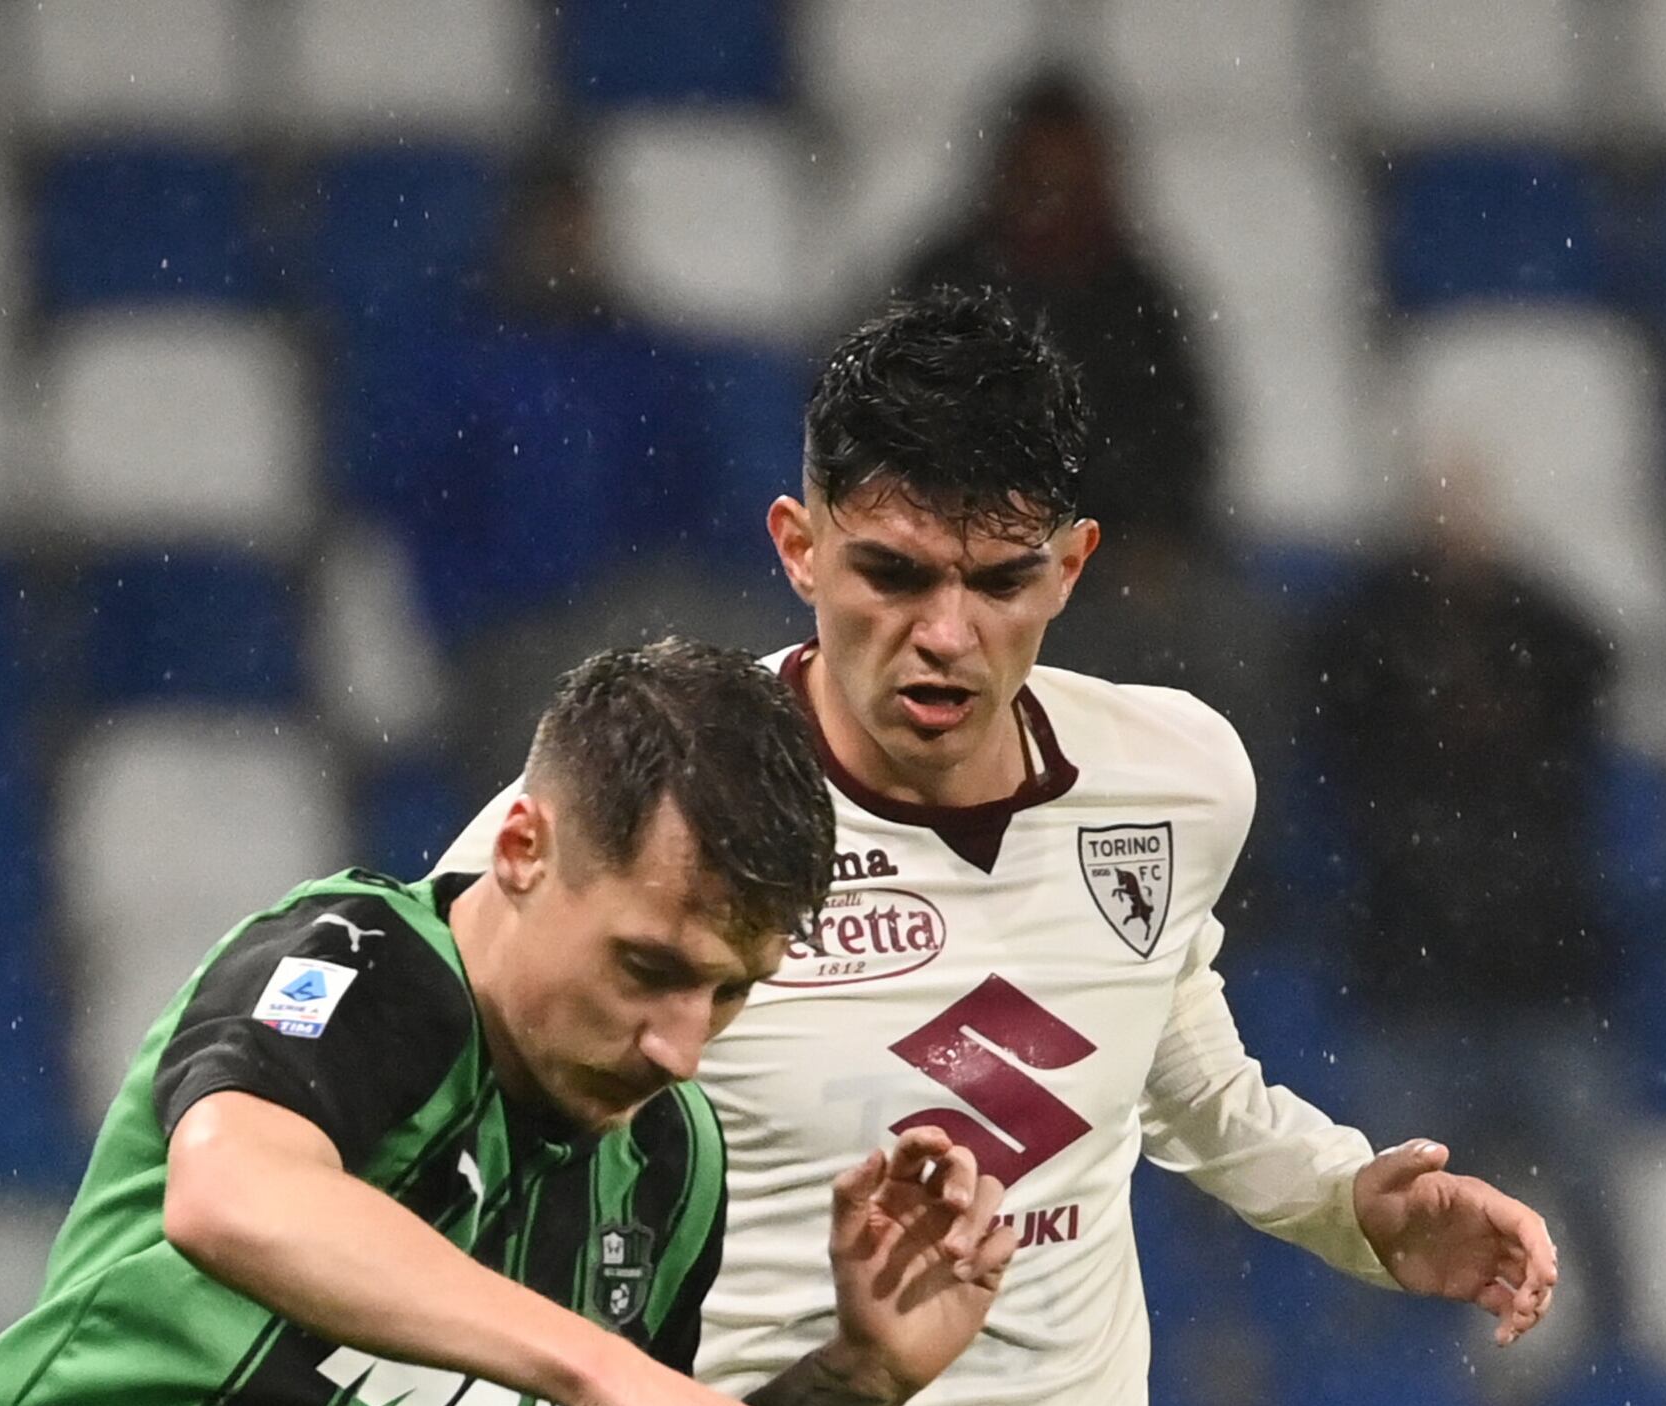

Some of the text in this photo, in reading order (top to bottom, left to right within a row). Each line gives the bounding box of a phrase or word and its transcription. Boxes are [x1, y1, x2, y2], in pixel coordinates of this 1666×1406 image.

[1088, 836, 1160, 857] TORINO
[833, 849, 899, 881] ma
[817, 961, 866, 976] 1812
[986, 1204, 1079, 1249] UKI
